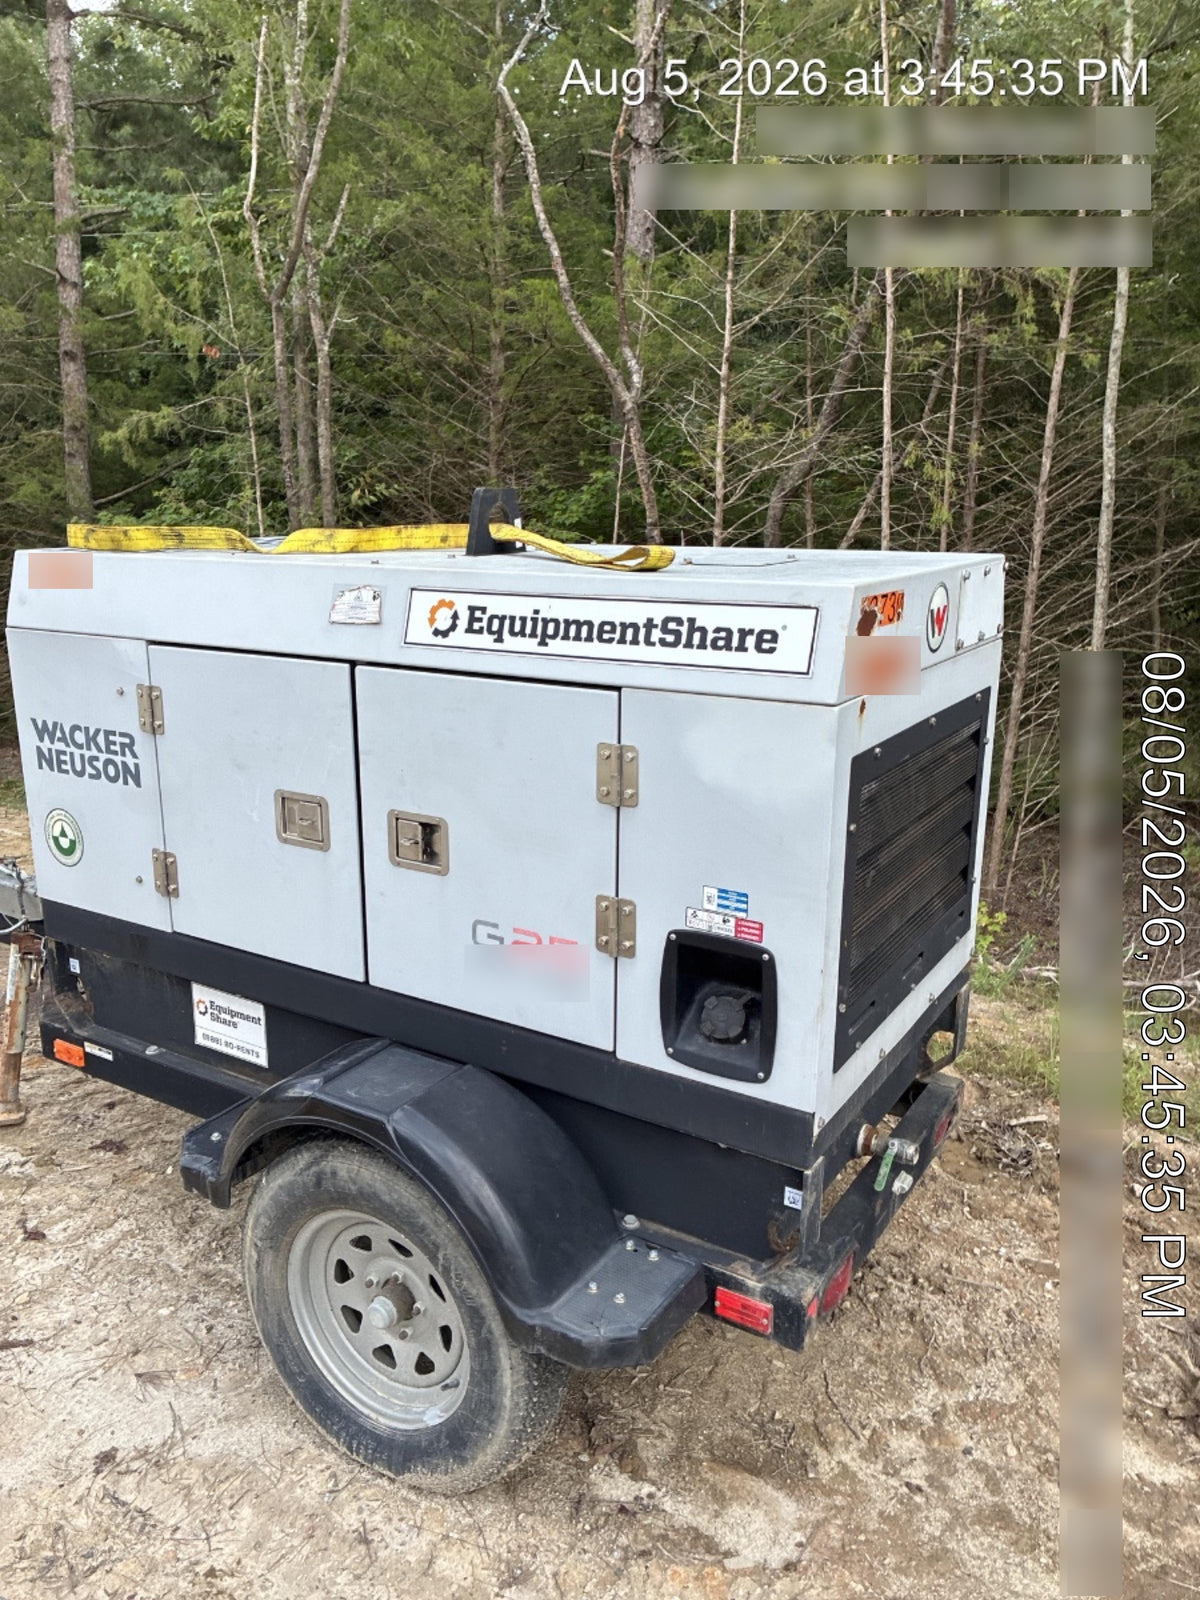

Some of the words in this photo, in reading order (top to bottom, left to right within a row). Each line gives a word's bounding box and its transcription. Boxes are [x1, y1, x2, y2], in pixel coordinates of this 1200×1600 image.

[464, 605, 779, 655] EquipmentShare
[30, 717, 140, 760] WACKER
[35, 745, 142, 789] NEUSON
[209, 1000, 262, 1025] Equipment
[210, 1012, 238, 1028] Share
